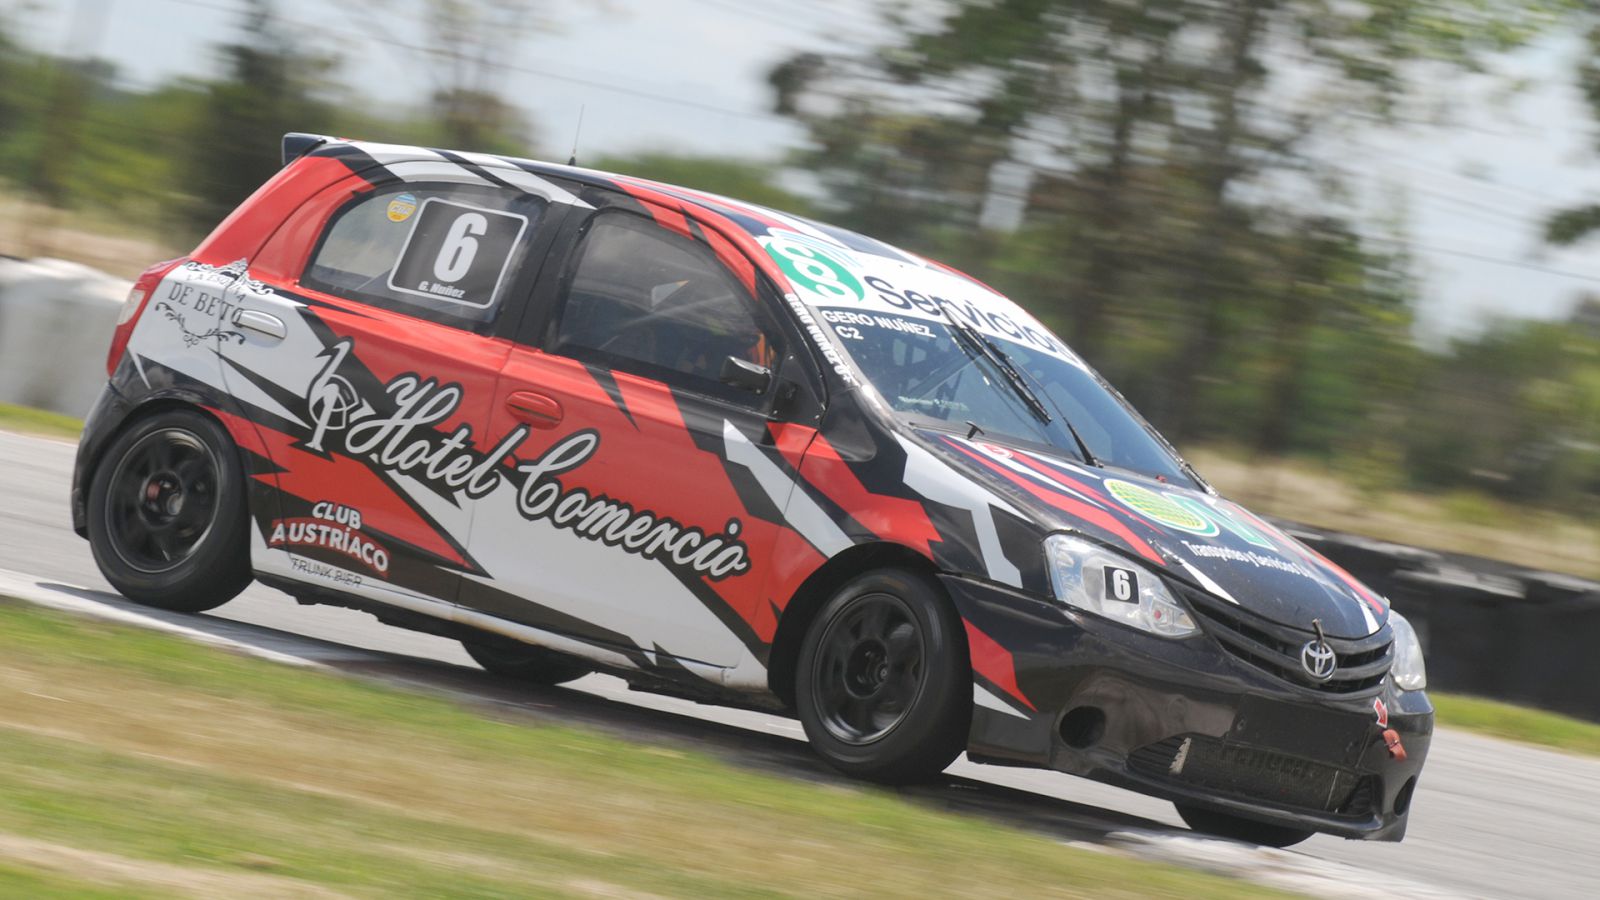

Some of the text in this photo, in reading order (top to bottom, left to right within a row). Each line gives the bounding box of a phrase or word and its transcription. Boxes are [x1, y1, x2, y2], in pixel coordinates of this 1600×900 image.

[433, 212, 488, 283] 6
[168, 282, 194, 306] DE
[431, 283, 466, 299] Nuñez
[821, 310, 937, 338] GERO NUÑEZ
[835, 325, 864, 340] C2
[345, 376, 747, 577] Hotel Comercio
[312, 501, 362, 530] CLUB
[1112, 569, 1131, 601] 6
